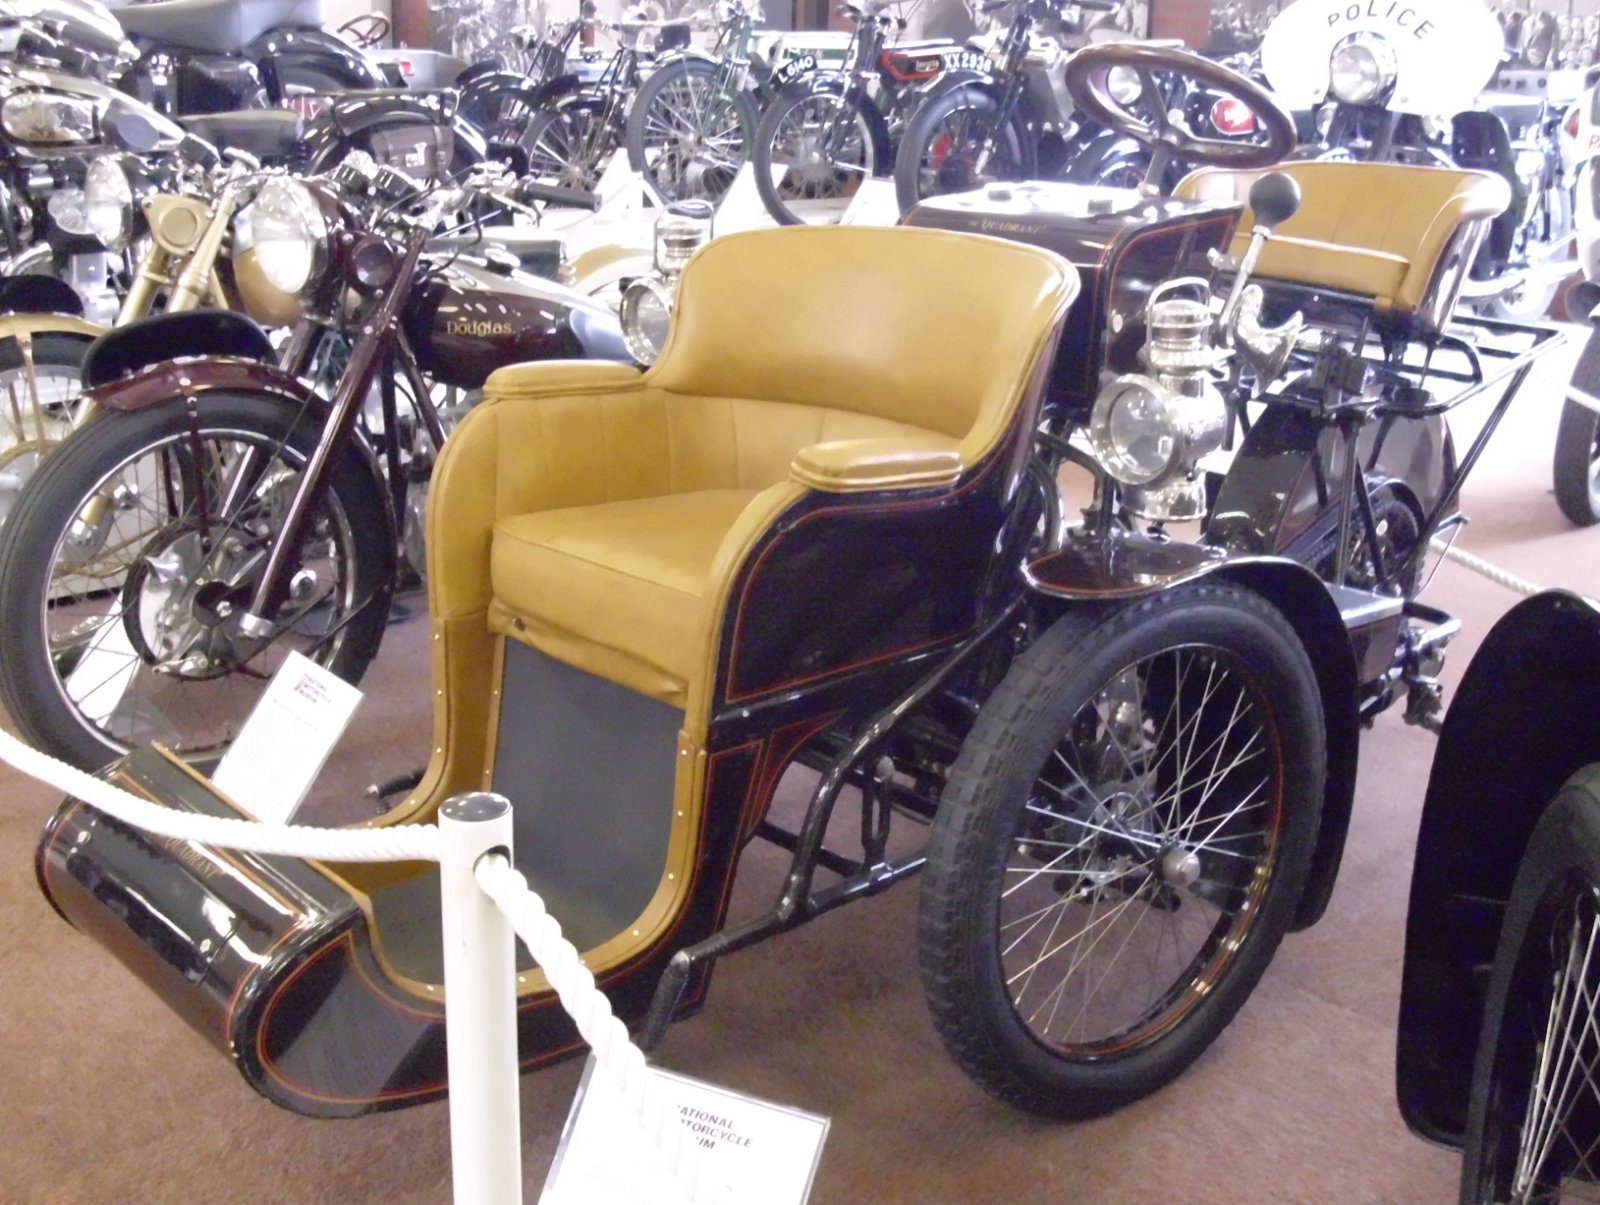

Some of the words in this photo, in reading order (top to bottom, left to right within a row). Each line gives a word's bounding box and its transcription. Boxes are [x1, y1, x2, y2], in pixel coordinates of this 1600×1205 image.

[1327, 0, 1435, 39] POLICE
[677, 1104, 734, 1130] ATIONAL
[681, 1118, 752, 1148] TORCYCLE
